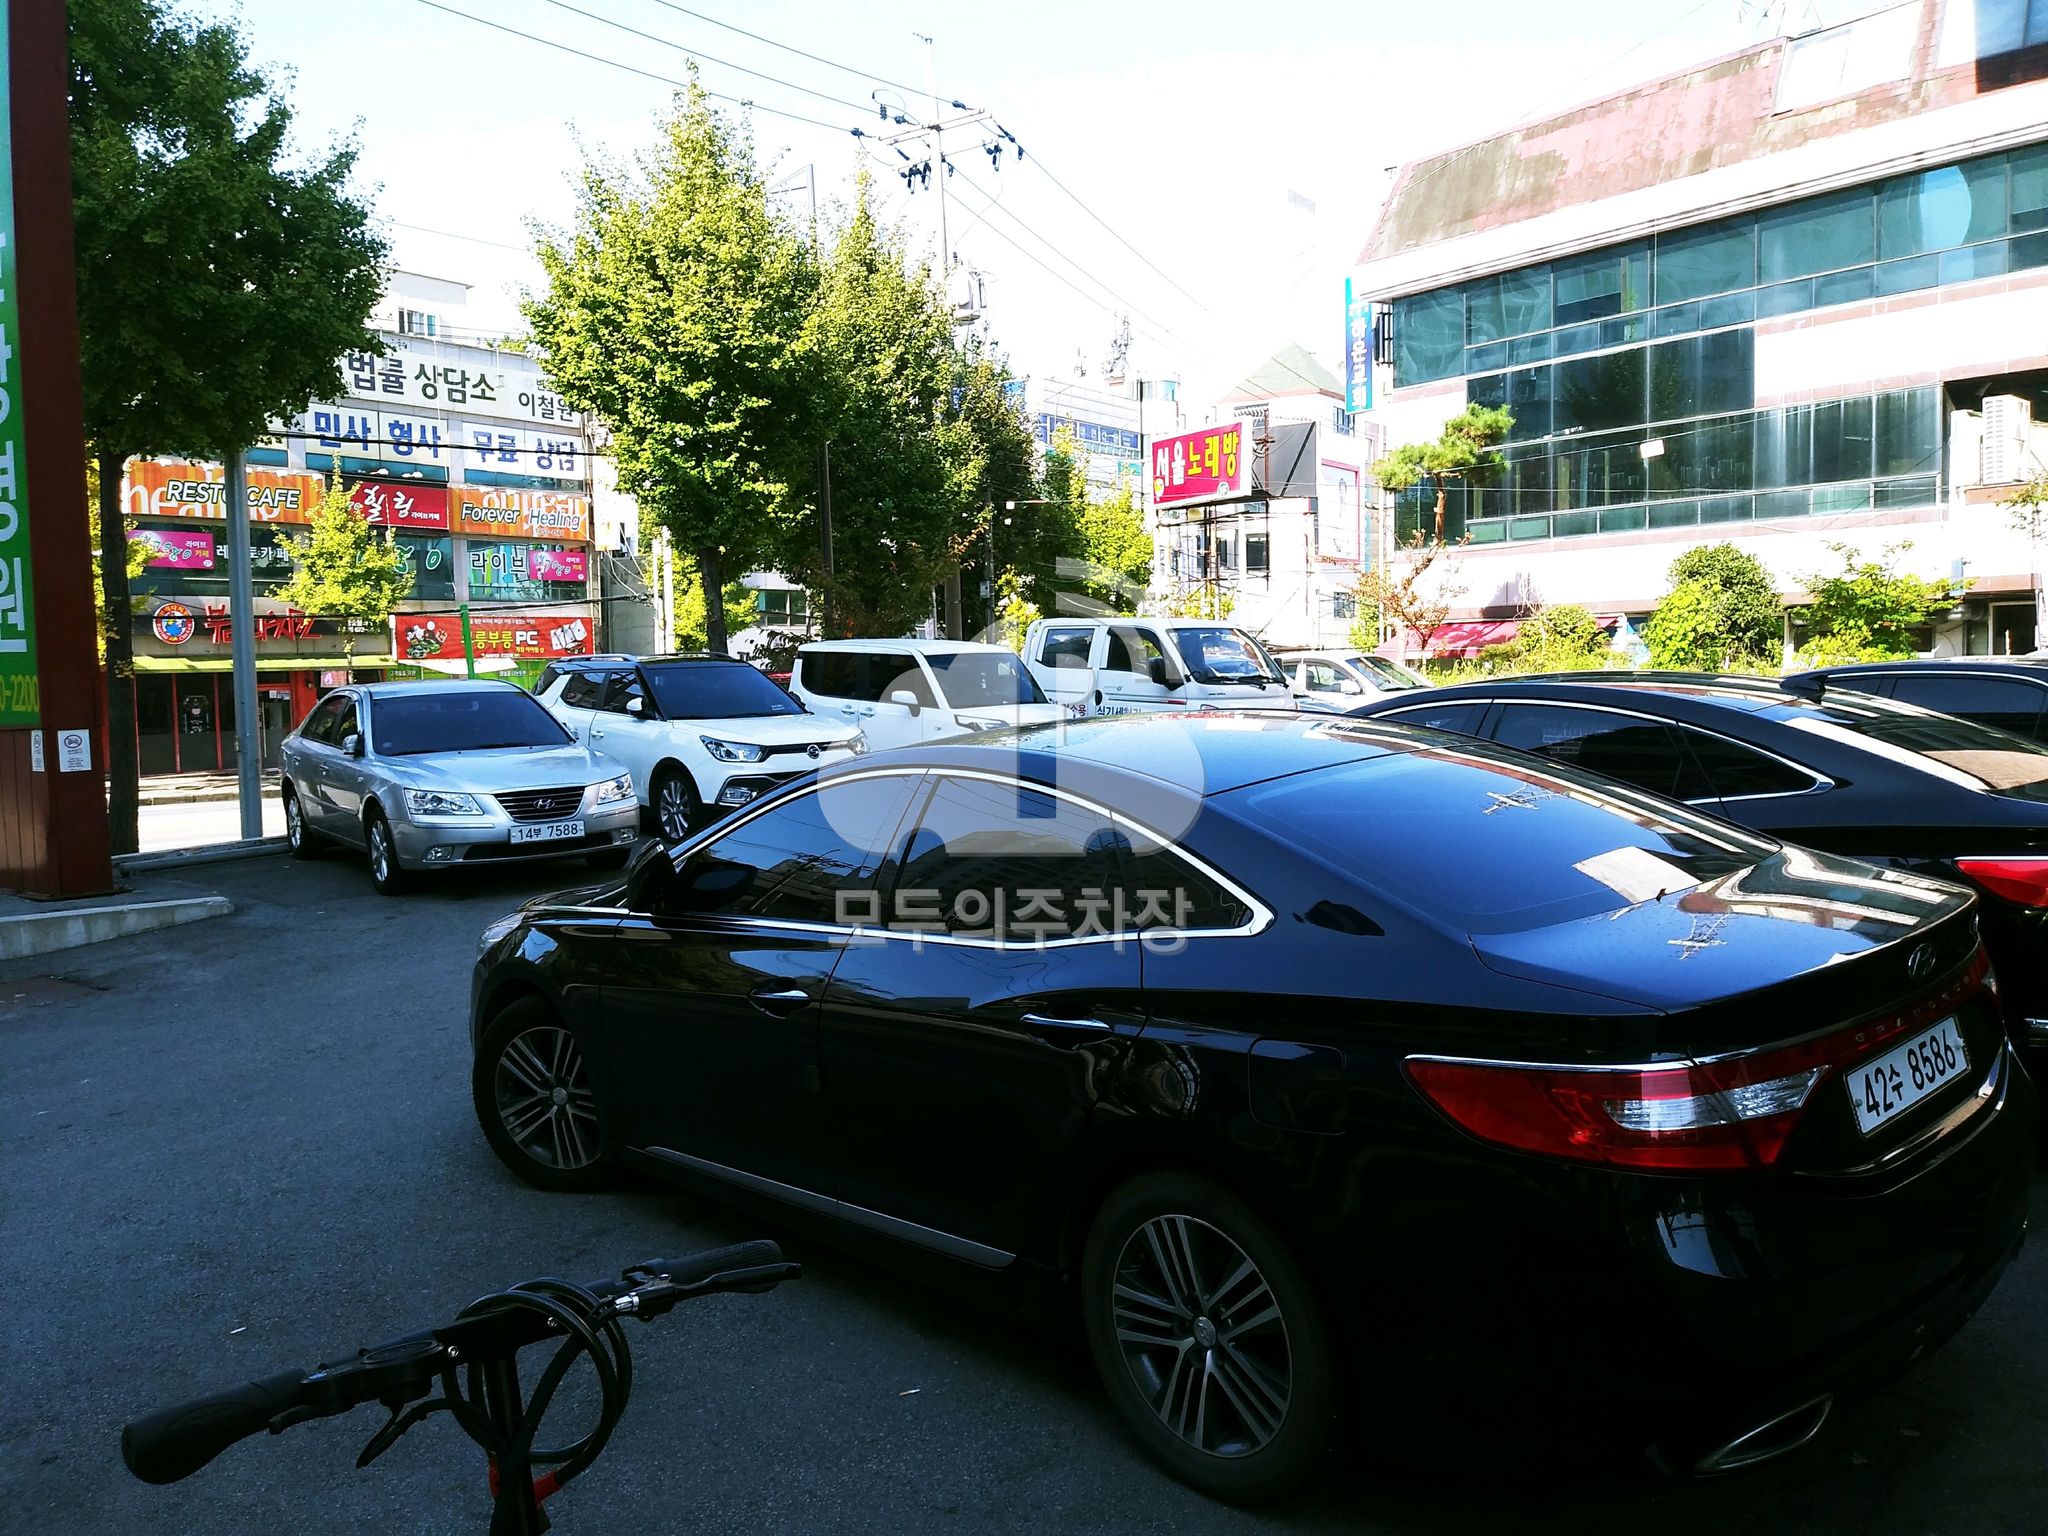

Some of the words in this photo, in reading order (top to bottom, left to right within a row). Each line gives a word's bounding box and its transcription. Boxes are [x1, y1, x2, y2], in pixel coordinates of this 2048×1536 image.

[348, 353, 407, 395] 법률
[414, 363, 497, 404] 상담소
[314, 411, 372, 452] 민사
[388, 420, 442, 458] 형사
[473, 431, 519, 463] 무료
[535, 437, 577, 472] 상담
[461, 502, 520, 525] Forever
[529, 509, 581, 531] Healing
[215, 544, 290, 562] 레토카페
[471, 550, 527, 574] 라이브
[515, 630, 539, 646] PC
[518, 827, 541, 841] 14부
[547, 823, 578, 837] 7588
[1864, 1063, 1904, 1118] 42수
[1907, 1029, 1956, 1091] 8586
